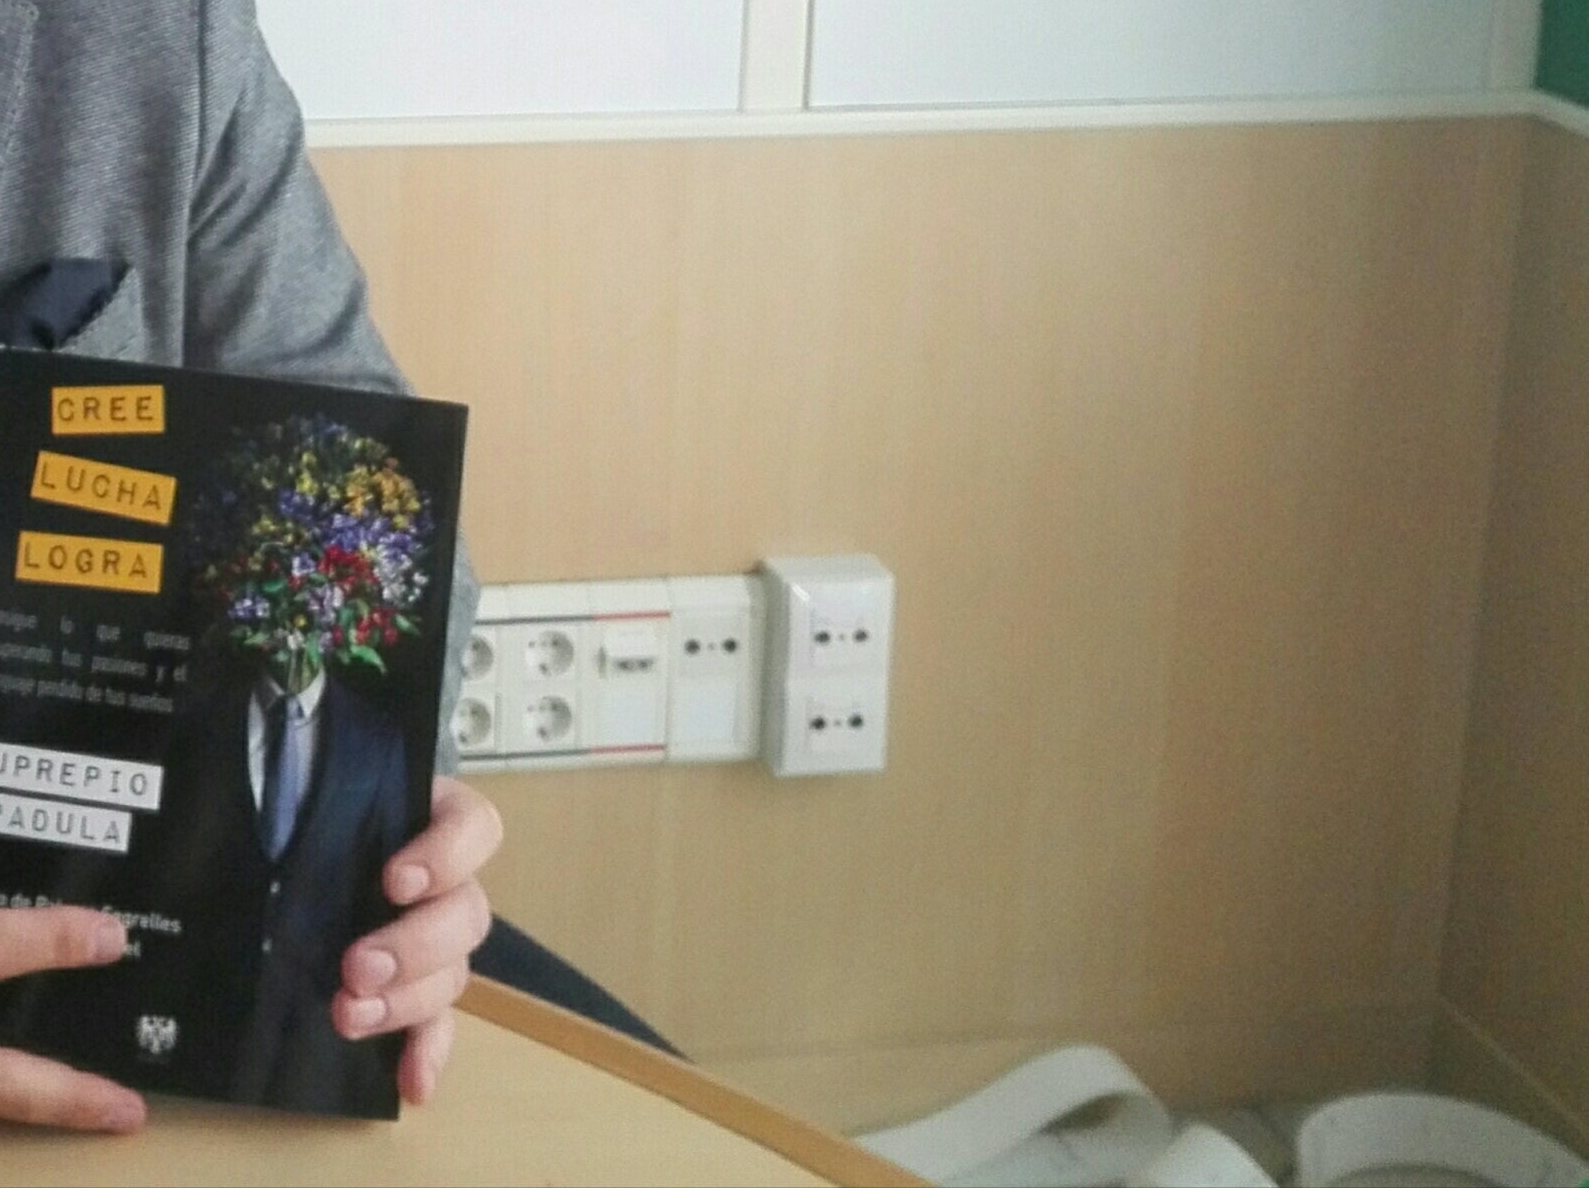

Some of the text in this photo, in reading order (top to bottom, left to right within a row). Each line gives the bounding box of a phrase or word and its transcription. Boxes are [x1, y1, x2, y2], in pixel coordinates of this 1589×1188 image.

[58, 396, 155, 422] CREE
[40, 461, 162, 511] LUCHA
[23, 541, 148, 579] LOGRA
